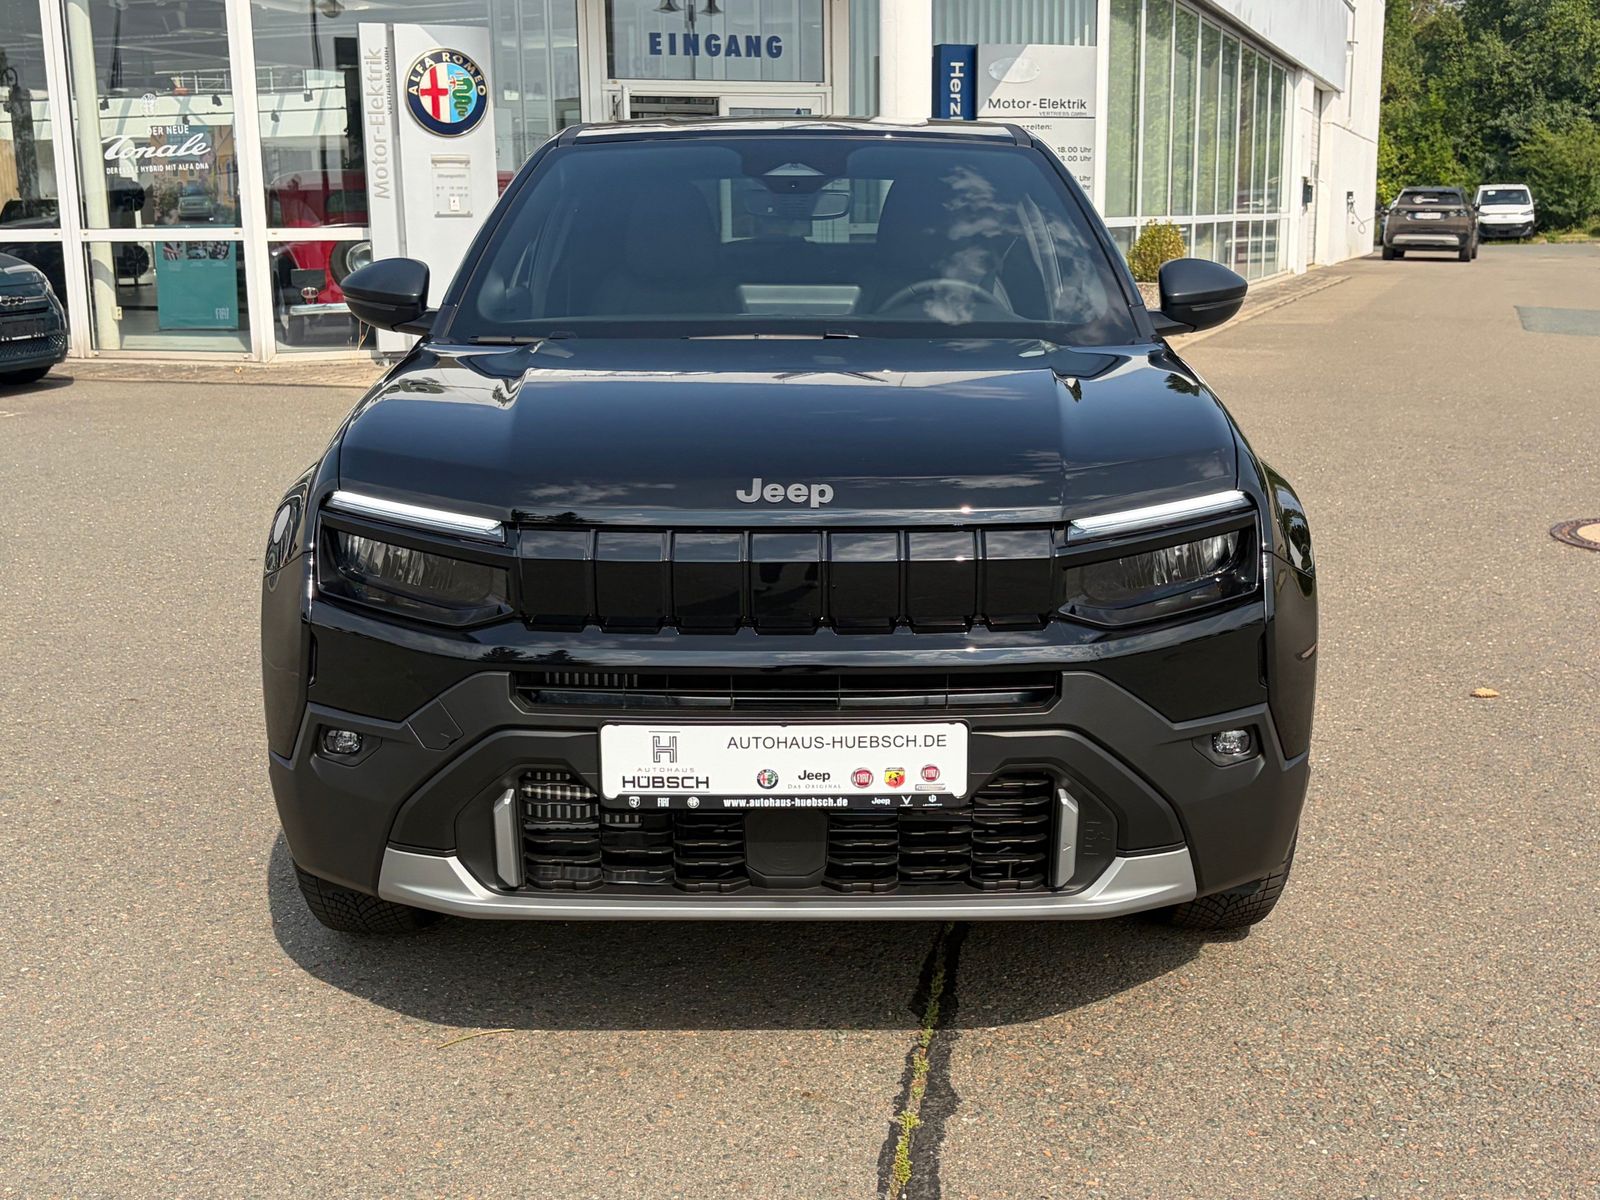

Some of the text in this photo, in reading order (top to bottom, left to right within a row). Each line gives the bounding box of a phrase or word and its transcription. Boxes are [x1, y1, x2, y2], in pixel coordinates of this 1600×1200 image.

[649, 32, 783, 59] EINGANG
[408, 52, 487, 96] ALFA ROMEO
[988, 98, 1087, 109] Motor-Elektrik
[166, 125, 190, 135] NEUE
[364, 48, 390, 200] Motor-Elektrik
[101, 133, 211, 160] Tonale
[736, 478, 834, 508] Jeep
[727, 735, 947, 749] AUTOHAUS-HUEBSCH.DE
[622, 776, 710, 789] HÜBSCH
[798, 770, 831, 782] Jeep
[723, 797, 848, 807] www.autohaus-huebsch.de
[871, 797, 891, 805] Jeep
